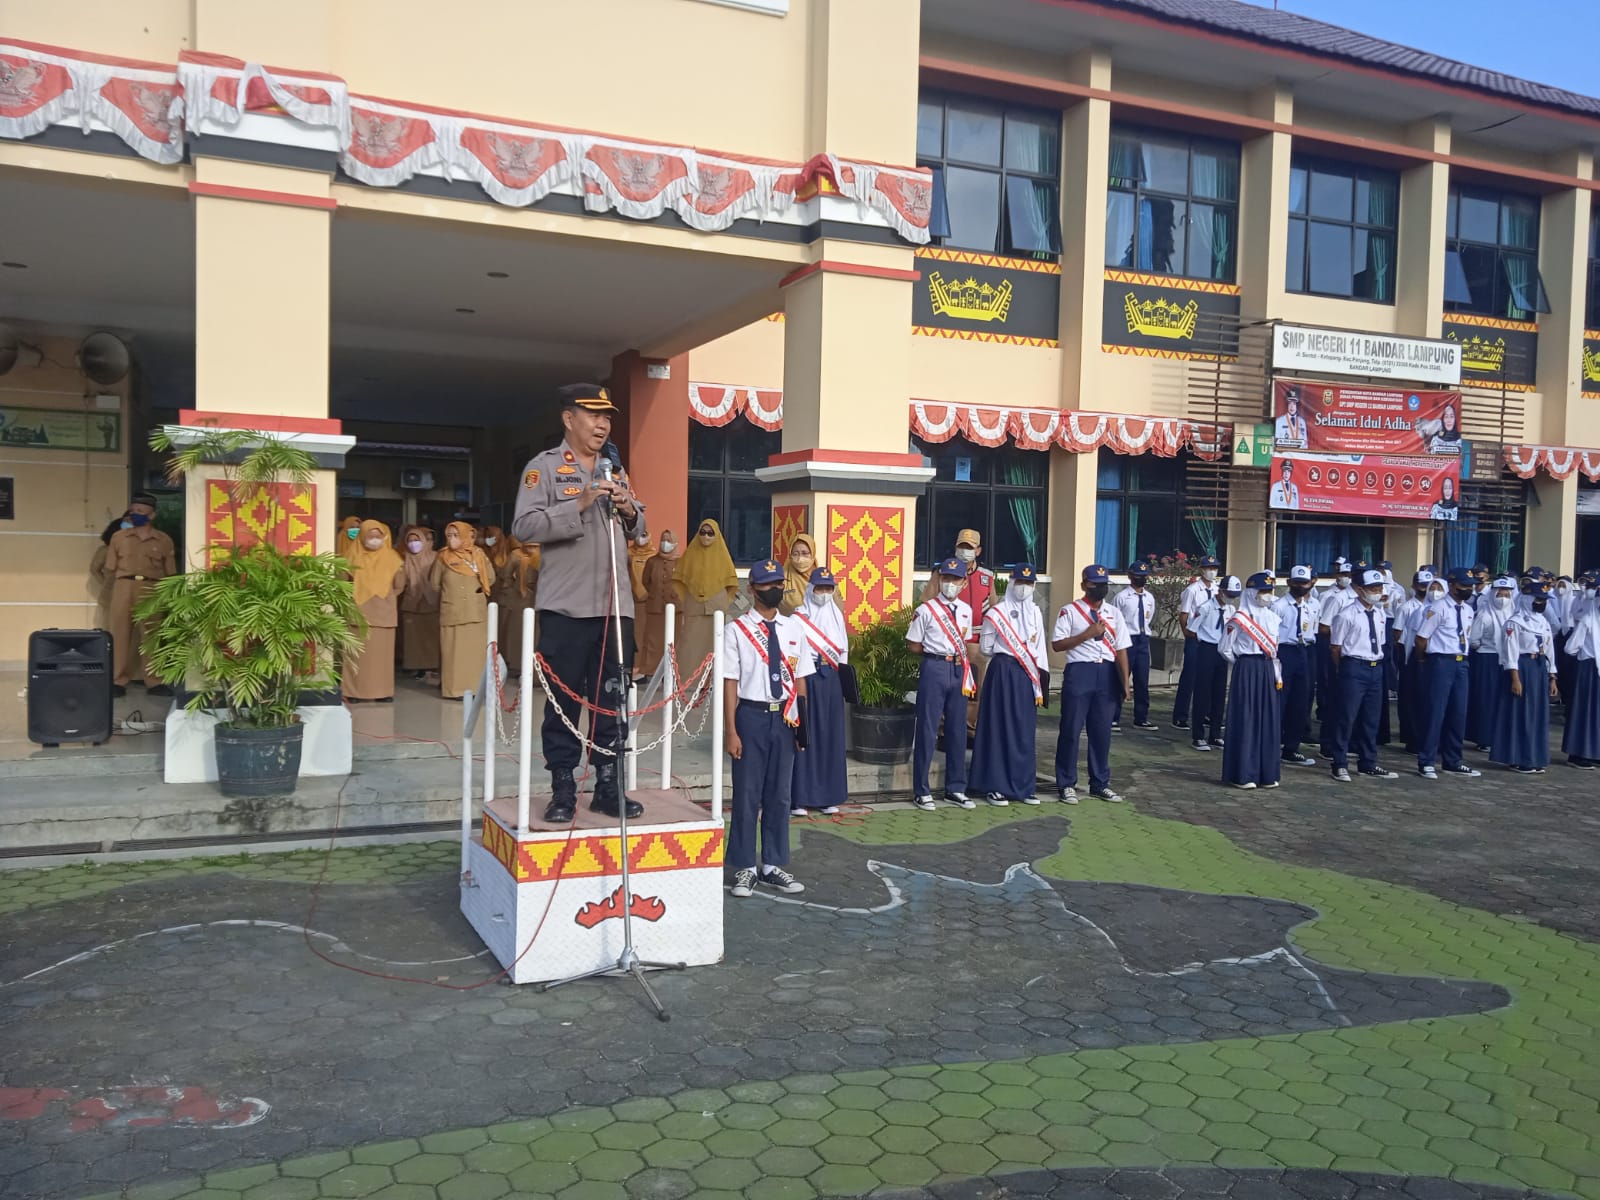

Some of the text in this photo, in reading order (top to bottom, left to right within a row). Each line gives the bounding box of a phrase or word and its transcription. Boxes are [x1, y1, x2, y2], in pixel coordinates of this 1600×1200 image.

[1282, 330, 1455, 365] SMP NEGERI 11 BANDAR LAMPUNG
[1314, 412, 1411, 430] Selamat Idul Adha
